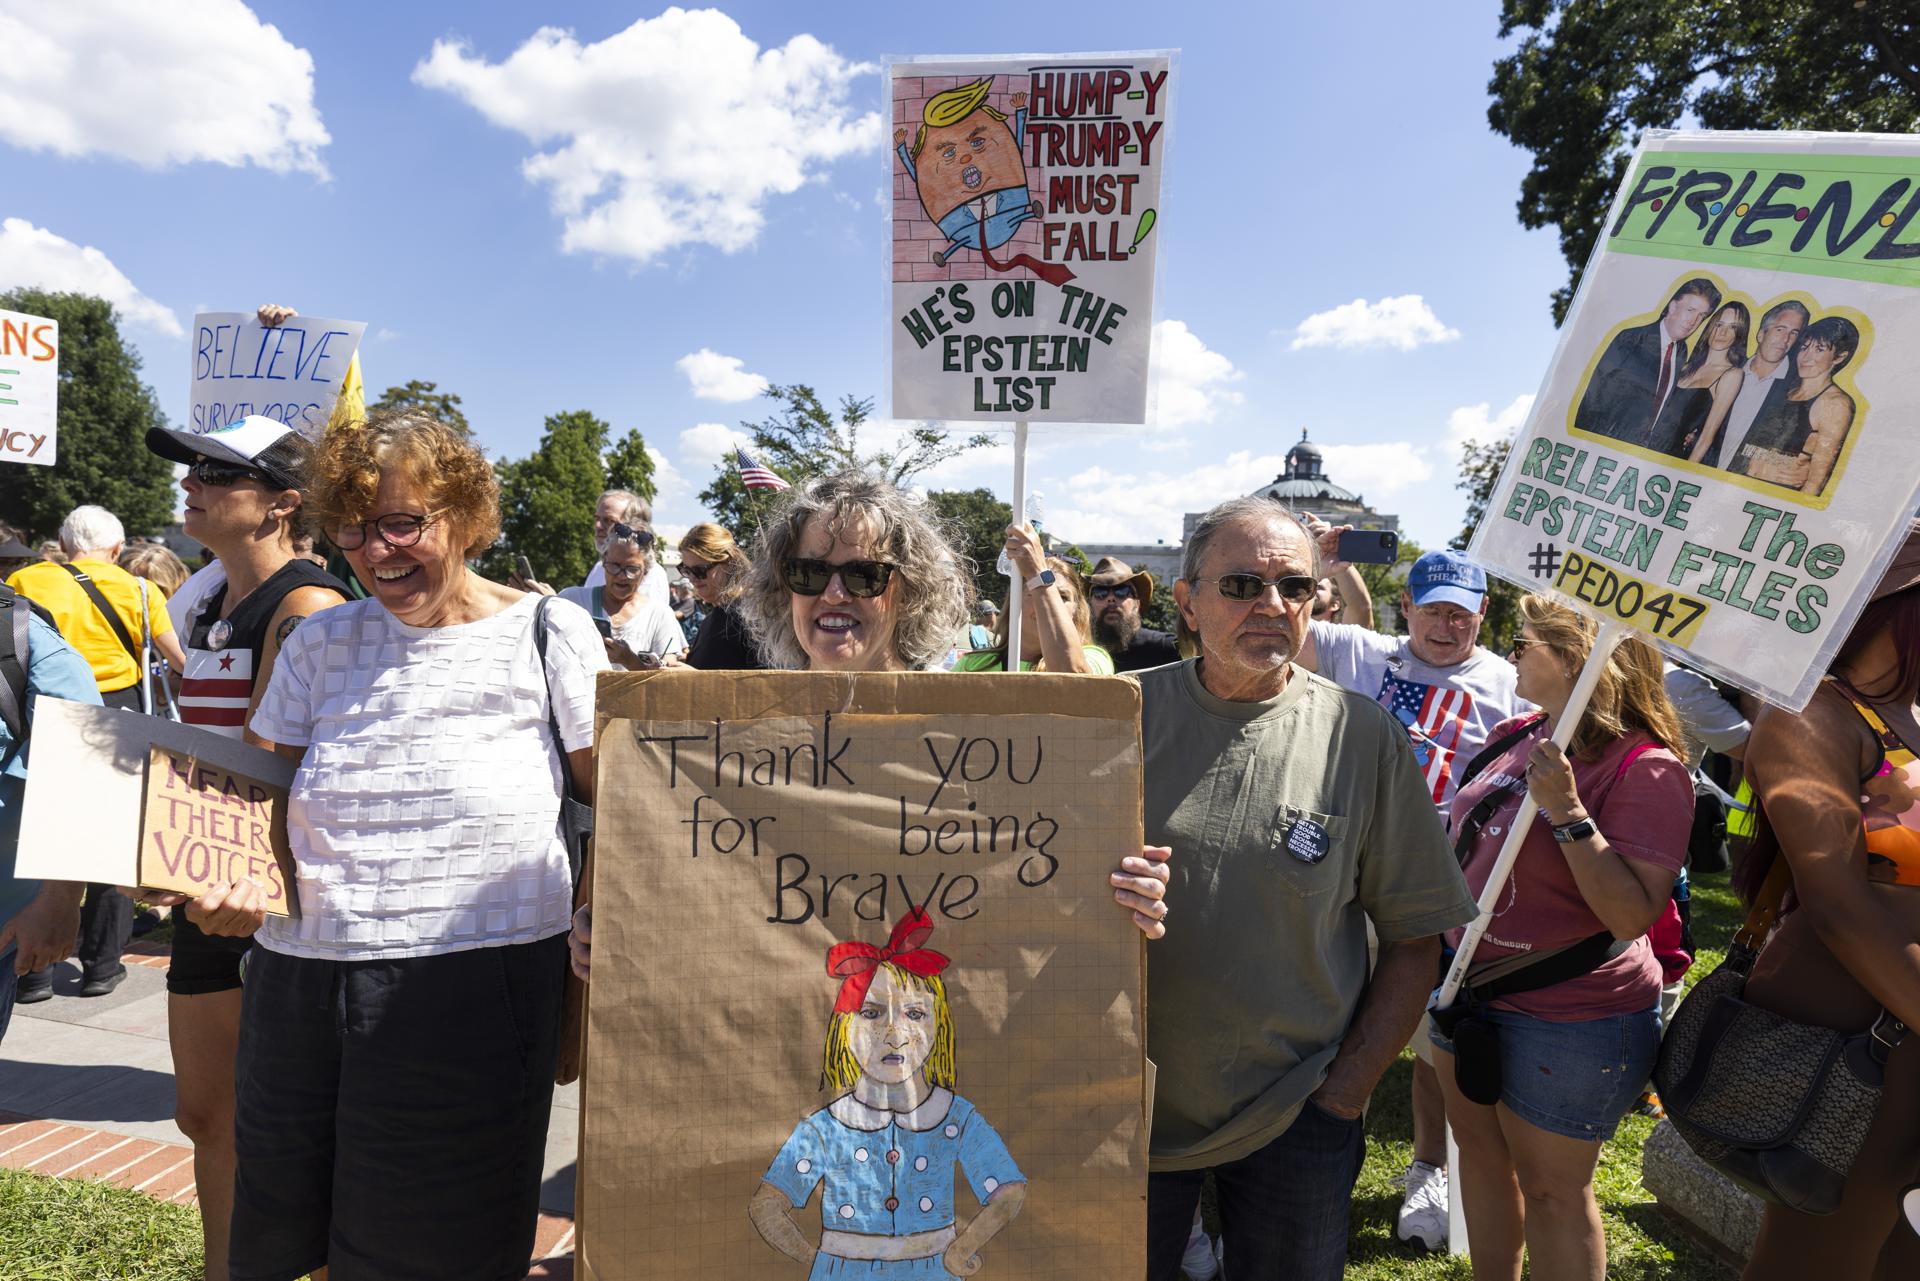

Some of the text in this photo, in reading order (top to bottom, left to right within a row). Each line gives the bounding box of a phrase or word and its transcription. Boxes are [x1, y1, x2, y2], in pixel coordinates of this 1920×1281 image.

[1029, 71, 1168, 117] HUMP-Y
[1026, 121, 1163, 167] TRUMP-Y
[1048, 174, 1139, 215] MUST
[1043, 208, 1156, 262] FALL!
[0, 318, 56, 361] NS
[901, 281, 1128, 349] HE'S ON THE
[196, 325, 349, 383] BELIEVE
[943, 335, 1091, 372] EPSTEIN
[973, 376, 1056, 413] LIST
[1521, 437, 1845, 580] RELEASE The
[1427, 573, 1449, 582] THE
[1503, 482, 1829, 634] EPSTEIN FILES
[1528, 542, 1707, 639] #PEDO47
[166, 756, 270, 822] HEAR
[638, 710, 1043, 815] Thank you
[157, 794, 271, 854] THEIR
[681, 795, 1059, 887] for being
[1293, 829, 1311, 840] GOOD
[767, 853, 979, 924] Brave
